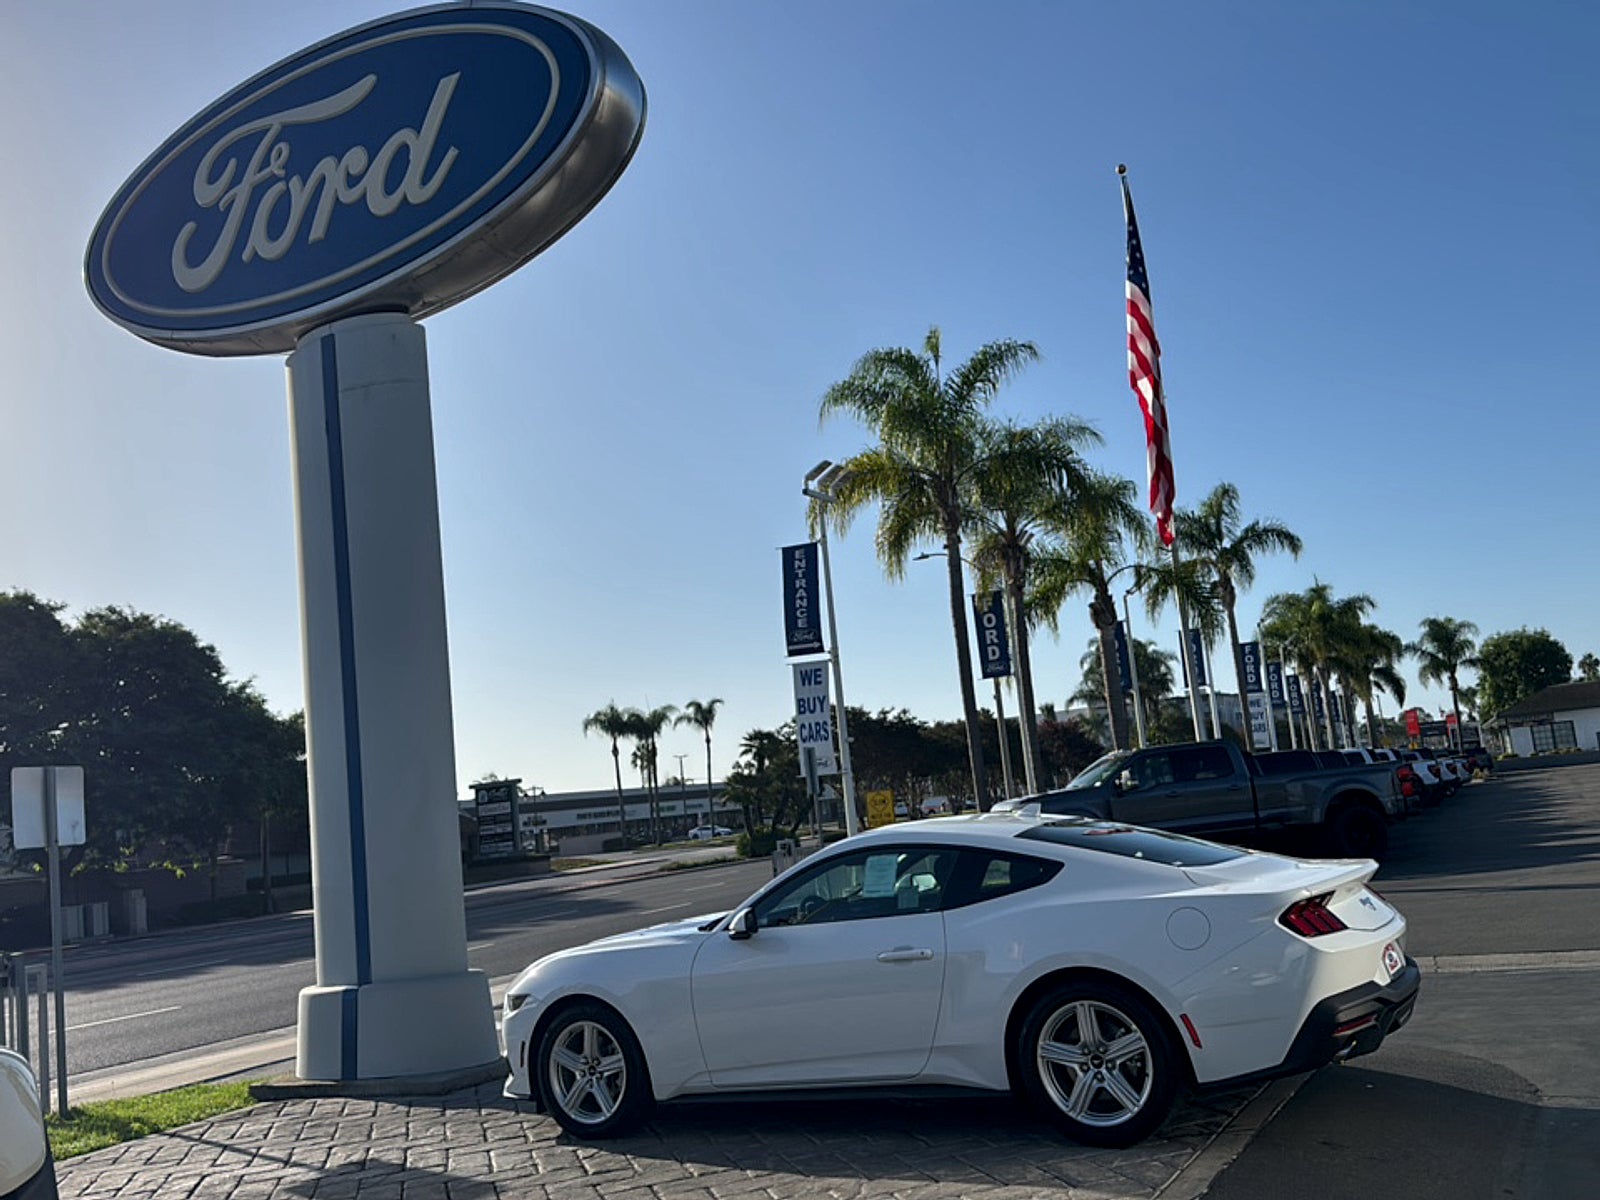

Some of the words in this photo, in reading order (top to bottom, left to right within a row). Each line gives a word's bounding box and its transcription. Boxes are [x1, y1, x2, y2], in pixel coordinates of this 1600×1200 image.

[171, 71, 461, 294] Ford
[794, 549, 808, 628] ENTRANCE
[800, 668, 822, 687] WE
[1244, 645, 1256, 683] FORD
[1269, 665, 1280, 698] FORD
[1289, 677, 1300, 706] FORD
[797, 695, 826, 715] BUY
[800, 720, 830, 743] CARS
